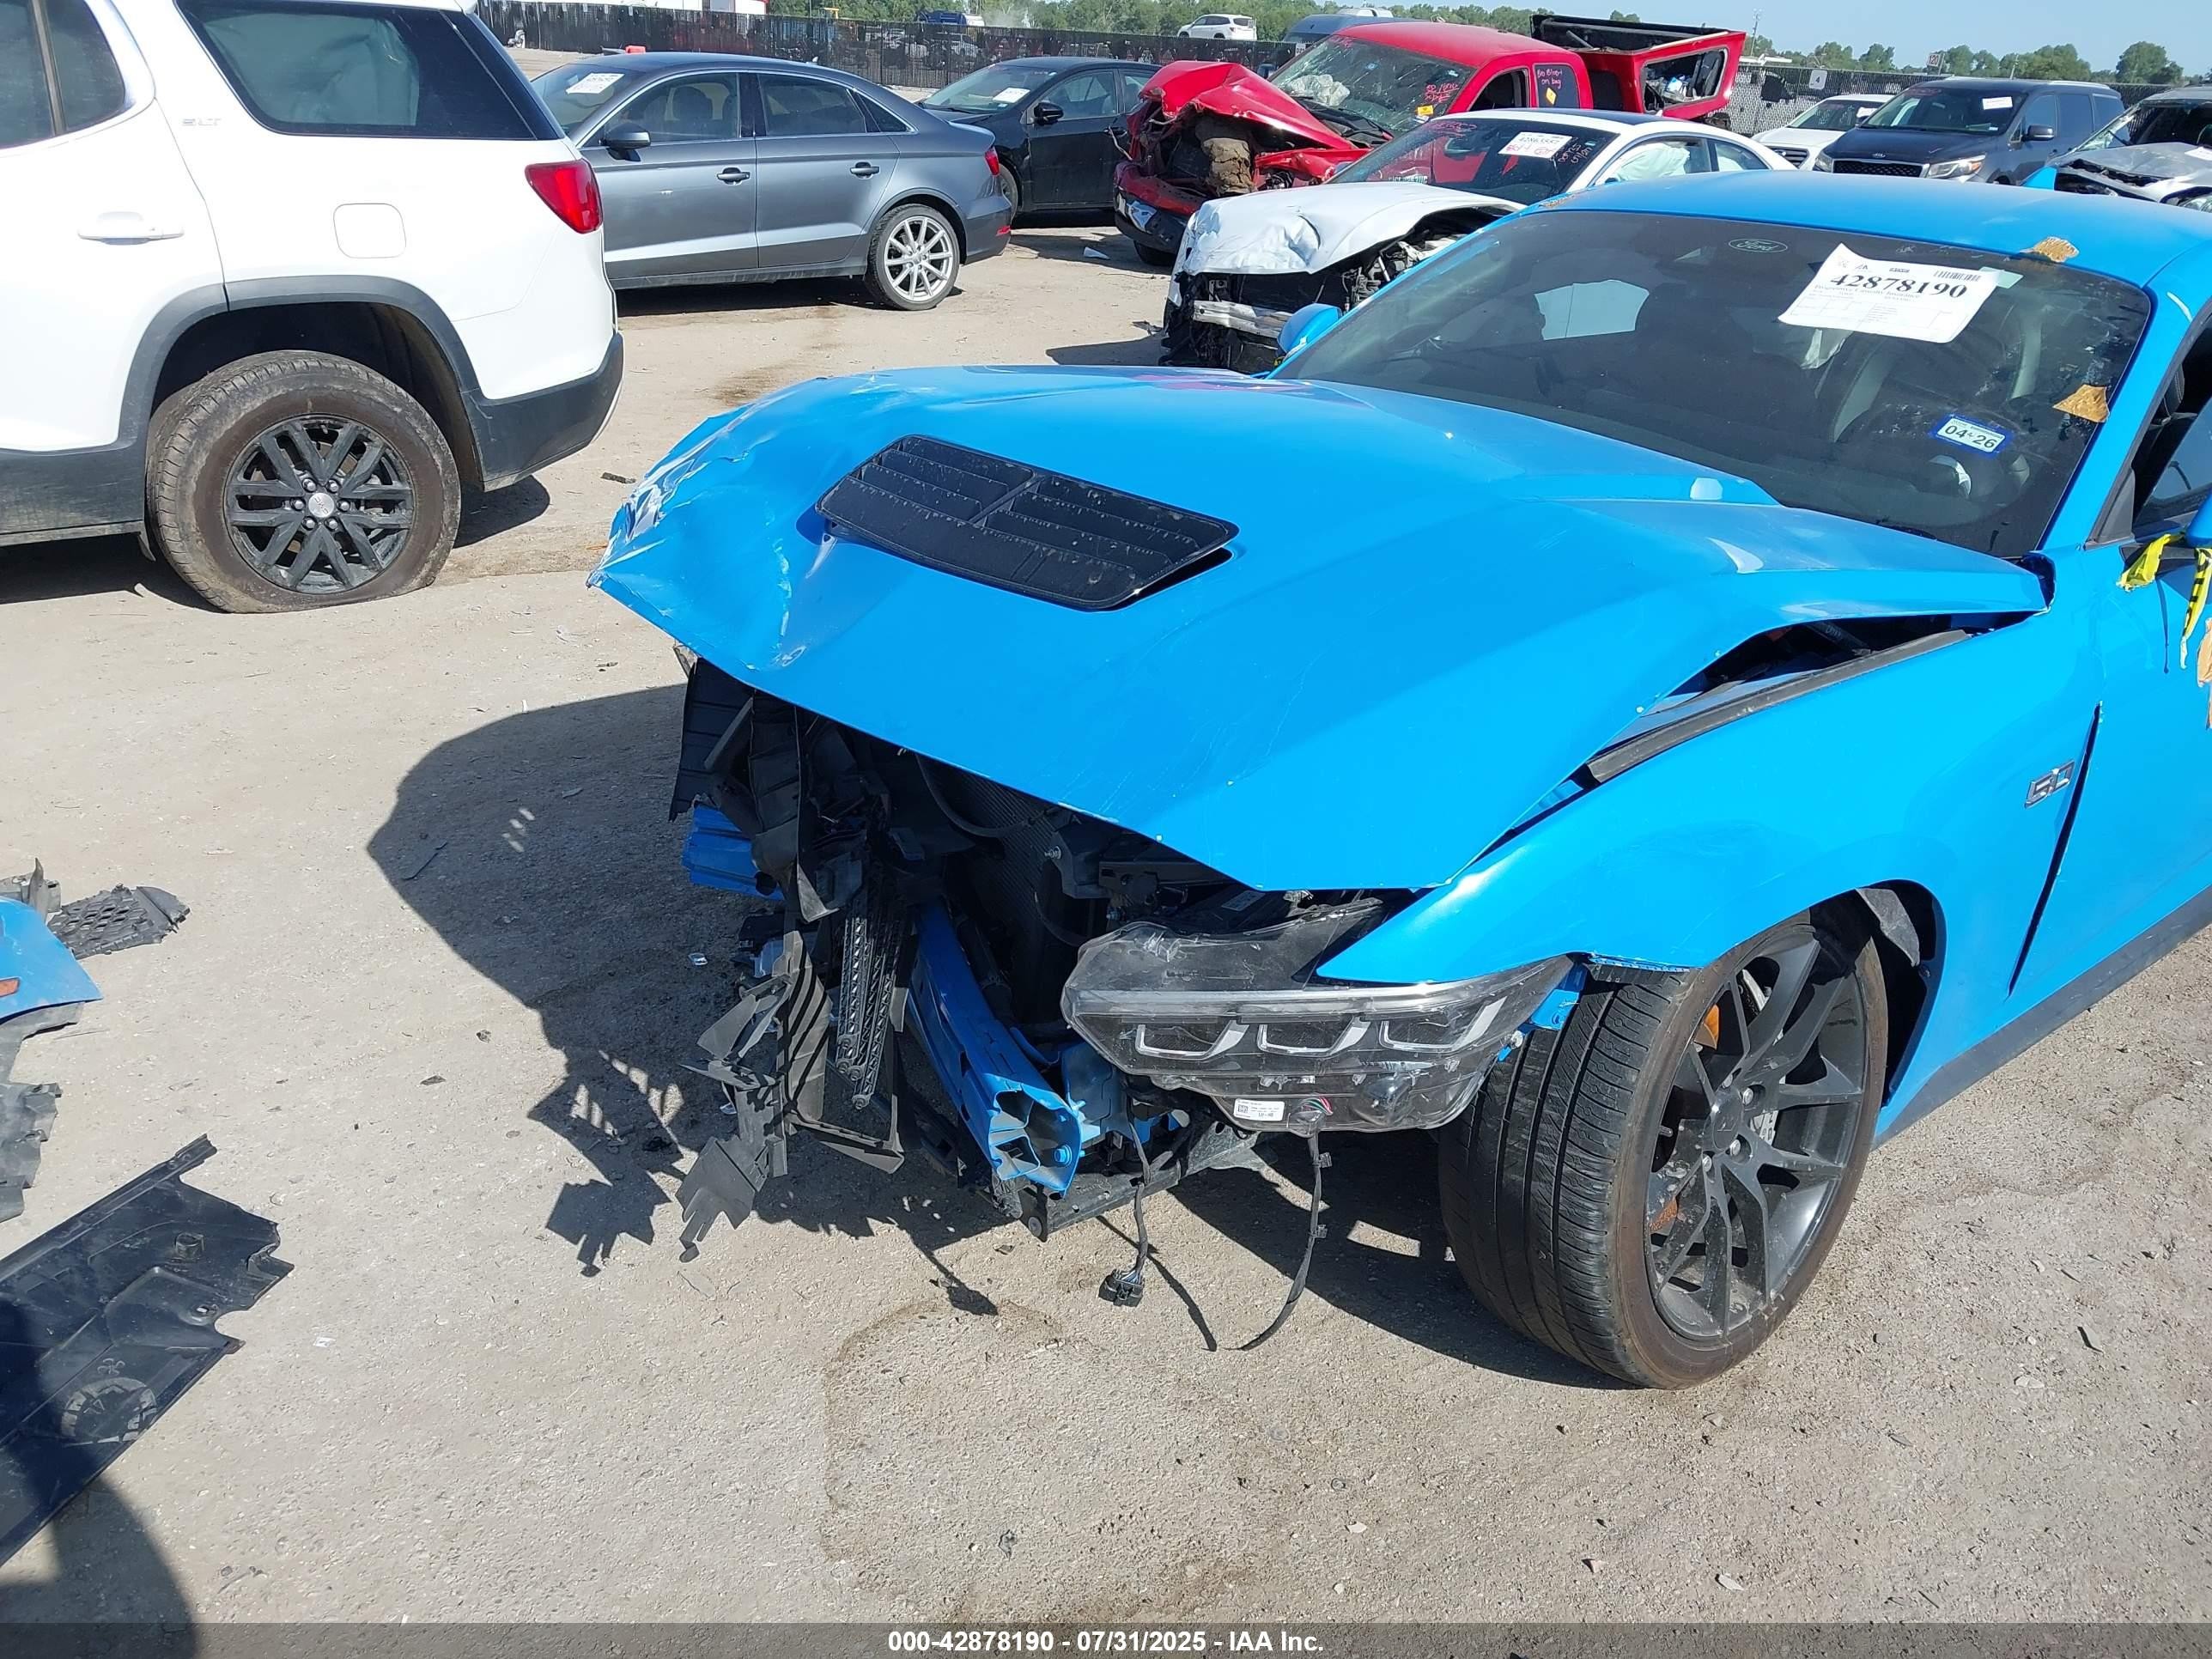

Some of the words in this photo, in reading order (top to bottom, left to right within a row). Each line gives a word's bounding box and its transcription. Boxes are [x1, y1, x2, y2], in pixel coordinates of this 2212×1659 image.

[1929, 54, 1939, 65] 120
[1733, 240, 1784, 252] Ford
[1830, 273, 1968, 298] 42878190
[1945, 425, 1967, 438] 04
[1972, 434, 1997, 448] 26
